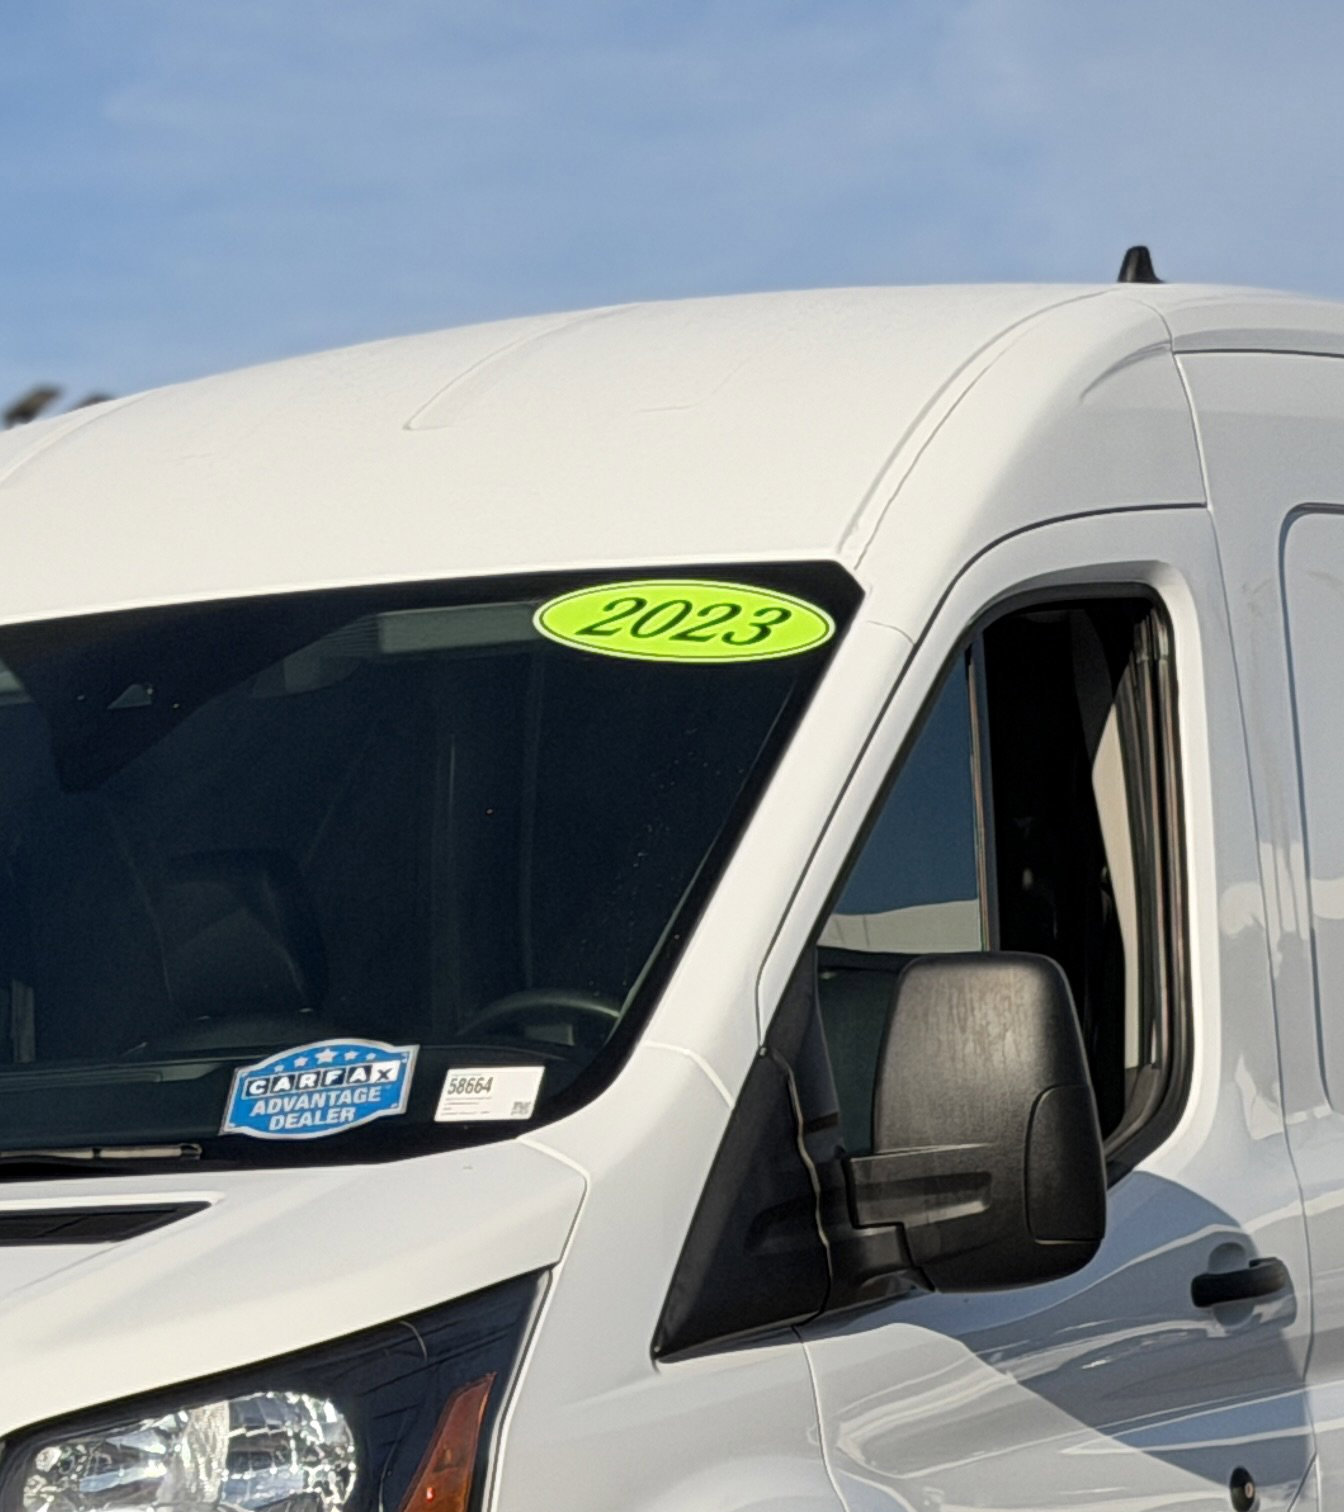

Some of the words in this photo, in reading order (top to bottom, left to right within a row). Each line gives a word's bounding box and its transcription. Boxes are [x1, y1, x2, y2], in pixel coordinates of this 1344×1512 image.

[574, 596, 792, 646] 2023
[248, 1066, 393, 1096] CARFAX
[447, 1076, 494, 1096] 58664
[249, 1087, 381, 1117] ADVANTAGE
[268, 1106, 356, 1131] DEALER
